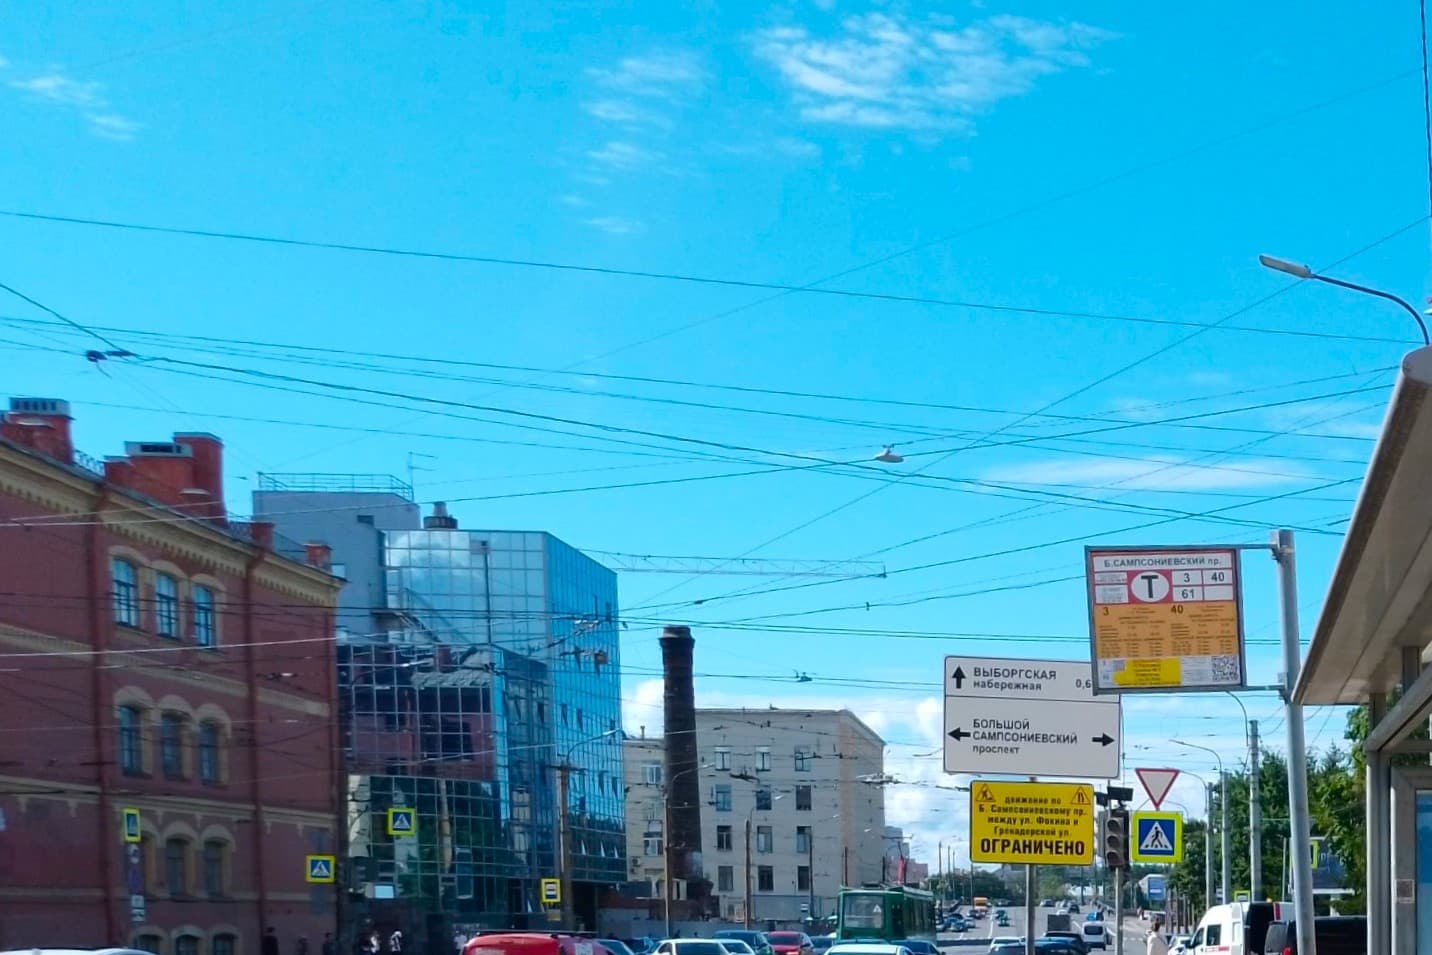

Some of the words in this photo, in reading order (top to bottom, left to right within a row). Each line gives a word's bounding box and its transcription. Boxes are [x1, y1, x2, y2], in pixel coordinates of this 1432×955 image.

[1207, 558, 1221, 567] пр.
[1183, 573, 1190, 583] 3
[1211, 571, 1225, 582] 40
[1181, 589, 1194, 599] 61
[1103, 606, 1109, 616] 3
[1170, 604, 1184, 614] 40
[974, 667, 1057, 680] ВЫБОРГСКАЯ
[973, 679, 1042, 691] набережная
[973, 718, 1030, 730] БОЛЬШОЙ
[972, 731, 1078, 744] САМПСОНИЕВСКИЙ
[972, 744, 1020, 755] проспект
[1051, 797, 1061, 805] по
[1073, 807, 1087, 817] пр.
[987, 816, 1016, 825] между
[1036, 816, 1070, 826] Фокина
[994, 826, 1055, 837] Гренадерской
[981, 838, 1085, 856] ОГРАНИЧЕНО
